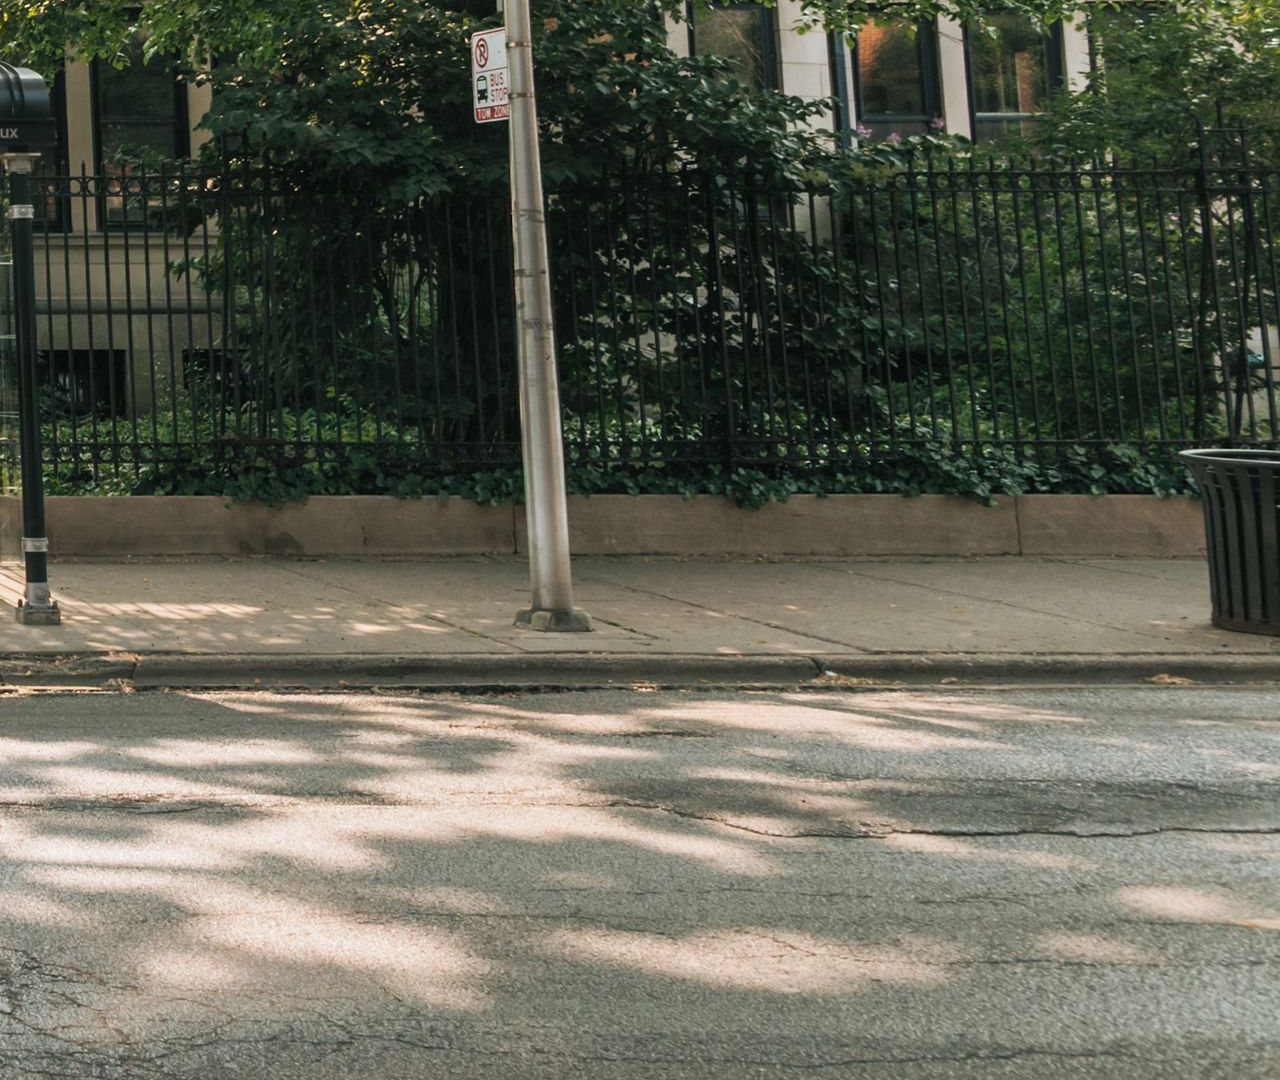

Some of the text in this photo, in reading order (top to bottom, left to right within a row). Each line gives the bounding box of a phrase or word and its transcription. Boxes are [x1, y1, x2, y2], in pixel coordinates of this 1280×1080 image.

[490, 71, 504, 87] BUS
[490, 87, 508, 103] STOP
[477, 107, 492, 120] TOW
